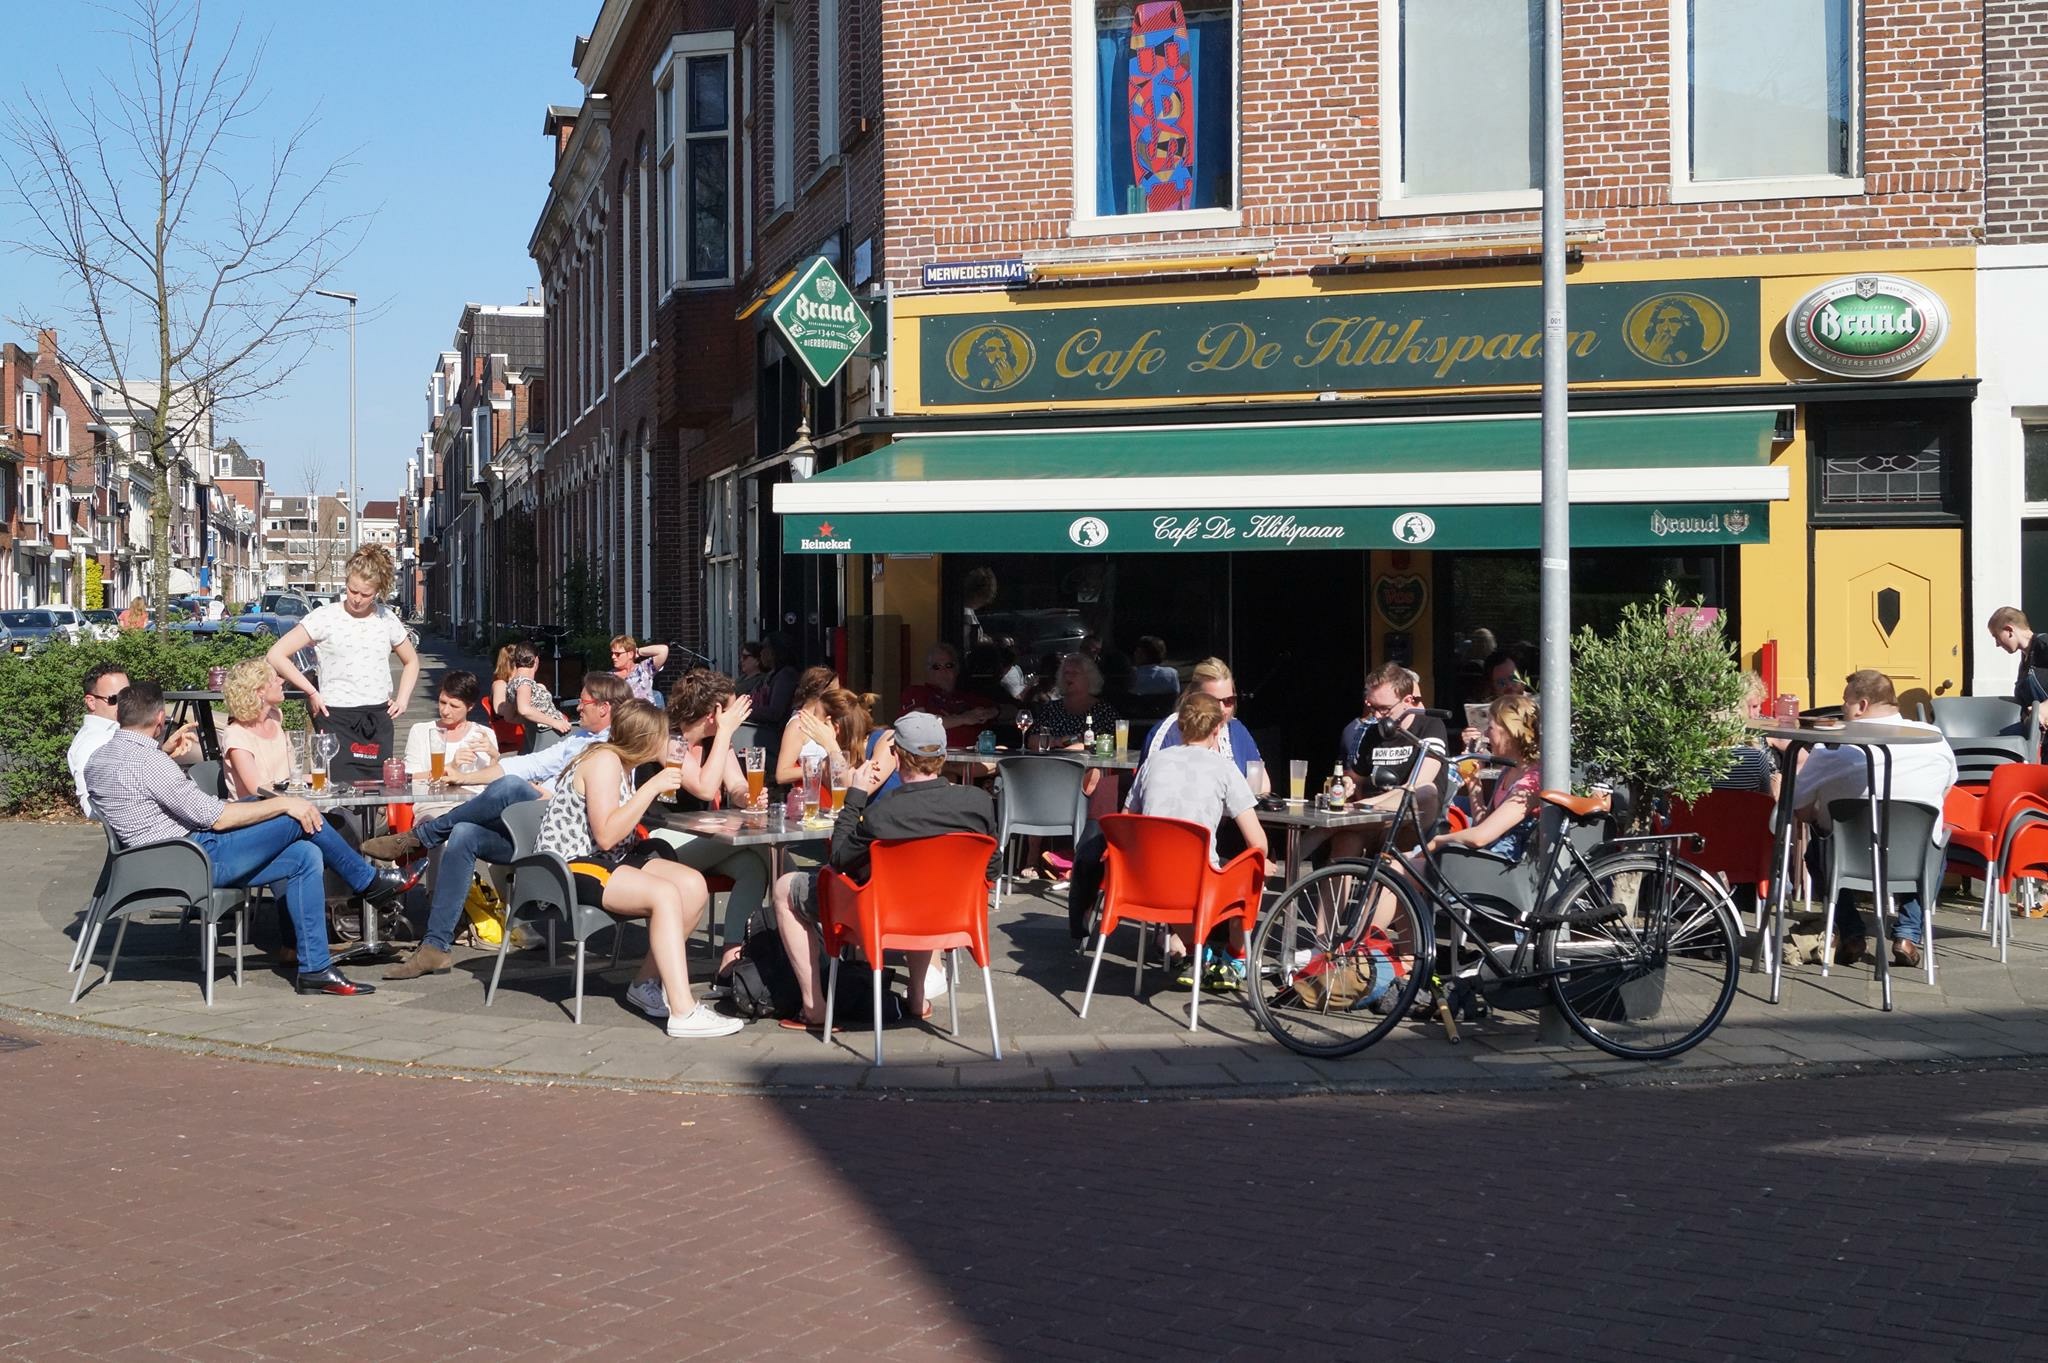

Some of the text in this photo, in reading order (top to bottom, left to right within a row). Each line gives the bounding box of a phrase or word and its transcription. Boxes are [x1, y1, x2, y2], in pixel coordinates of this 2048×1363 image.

[927, 263, 1024, 281] MERWEDESTRAAT
[796, 293, 856, 322] Brand
[1820, 303, 1916, 341] Brand
[1055, 316, 1601, 390] Cafe De Klikspaan
[1153, 515, 1345, 547] Café De Klikspaan
[1650, 509, 1720, 536] Brand
[801, 538, 851, 549] Heineken
